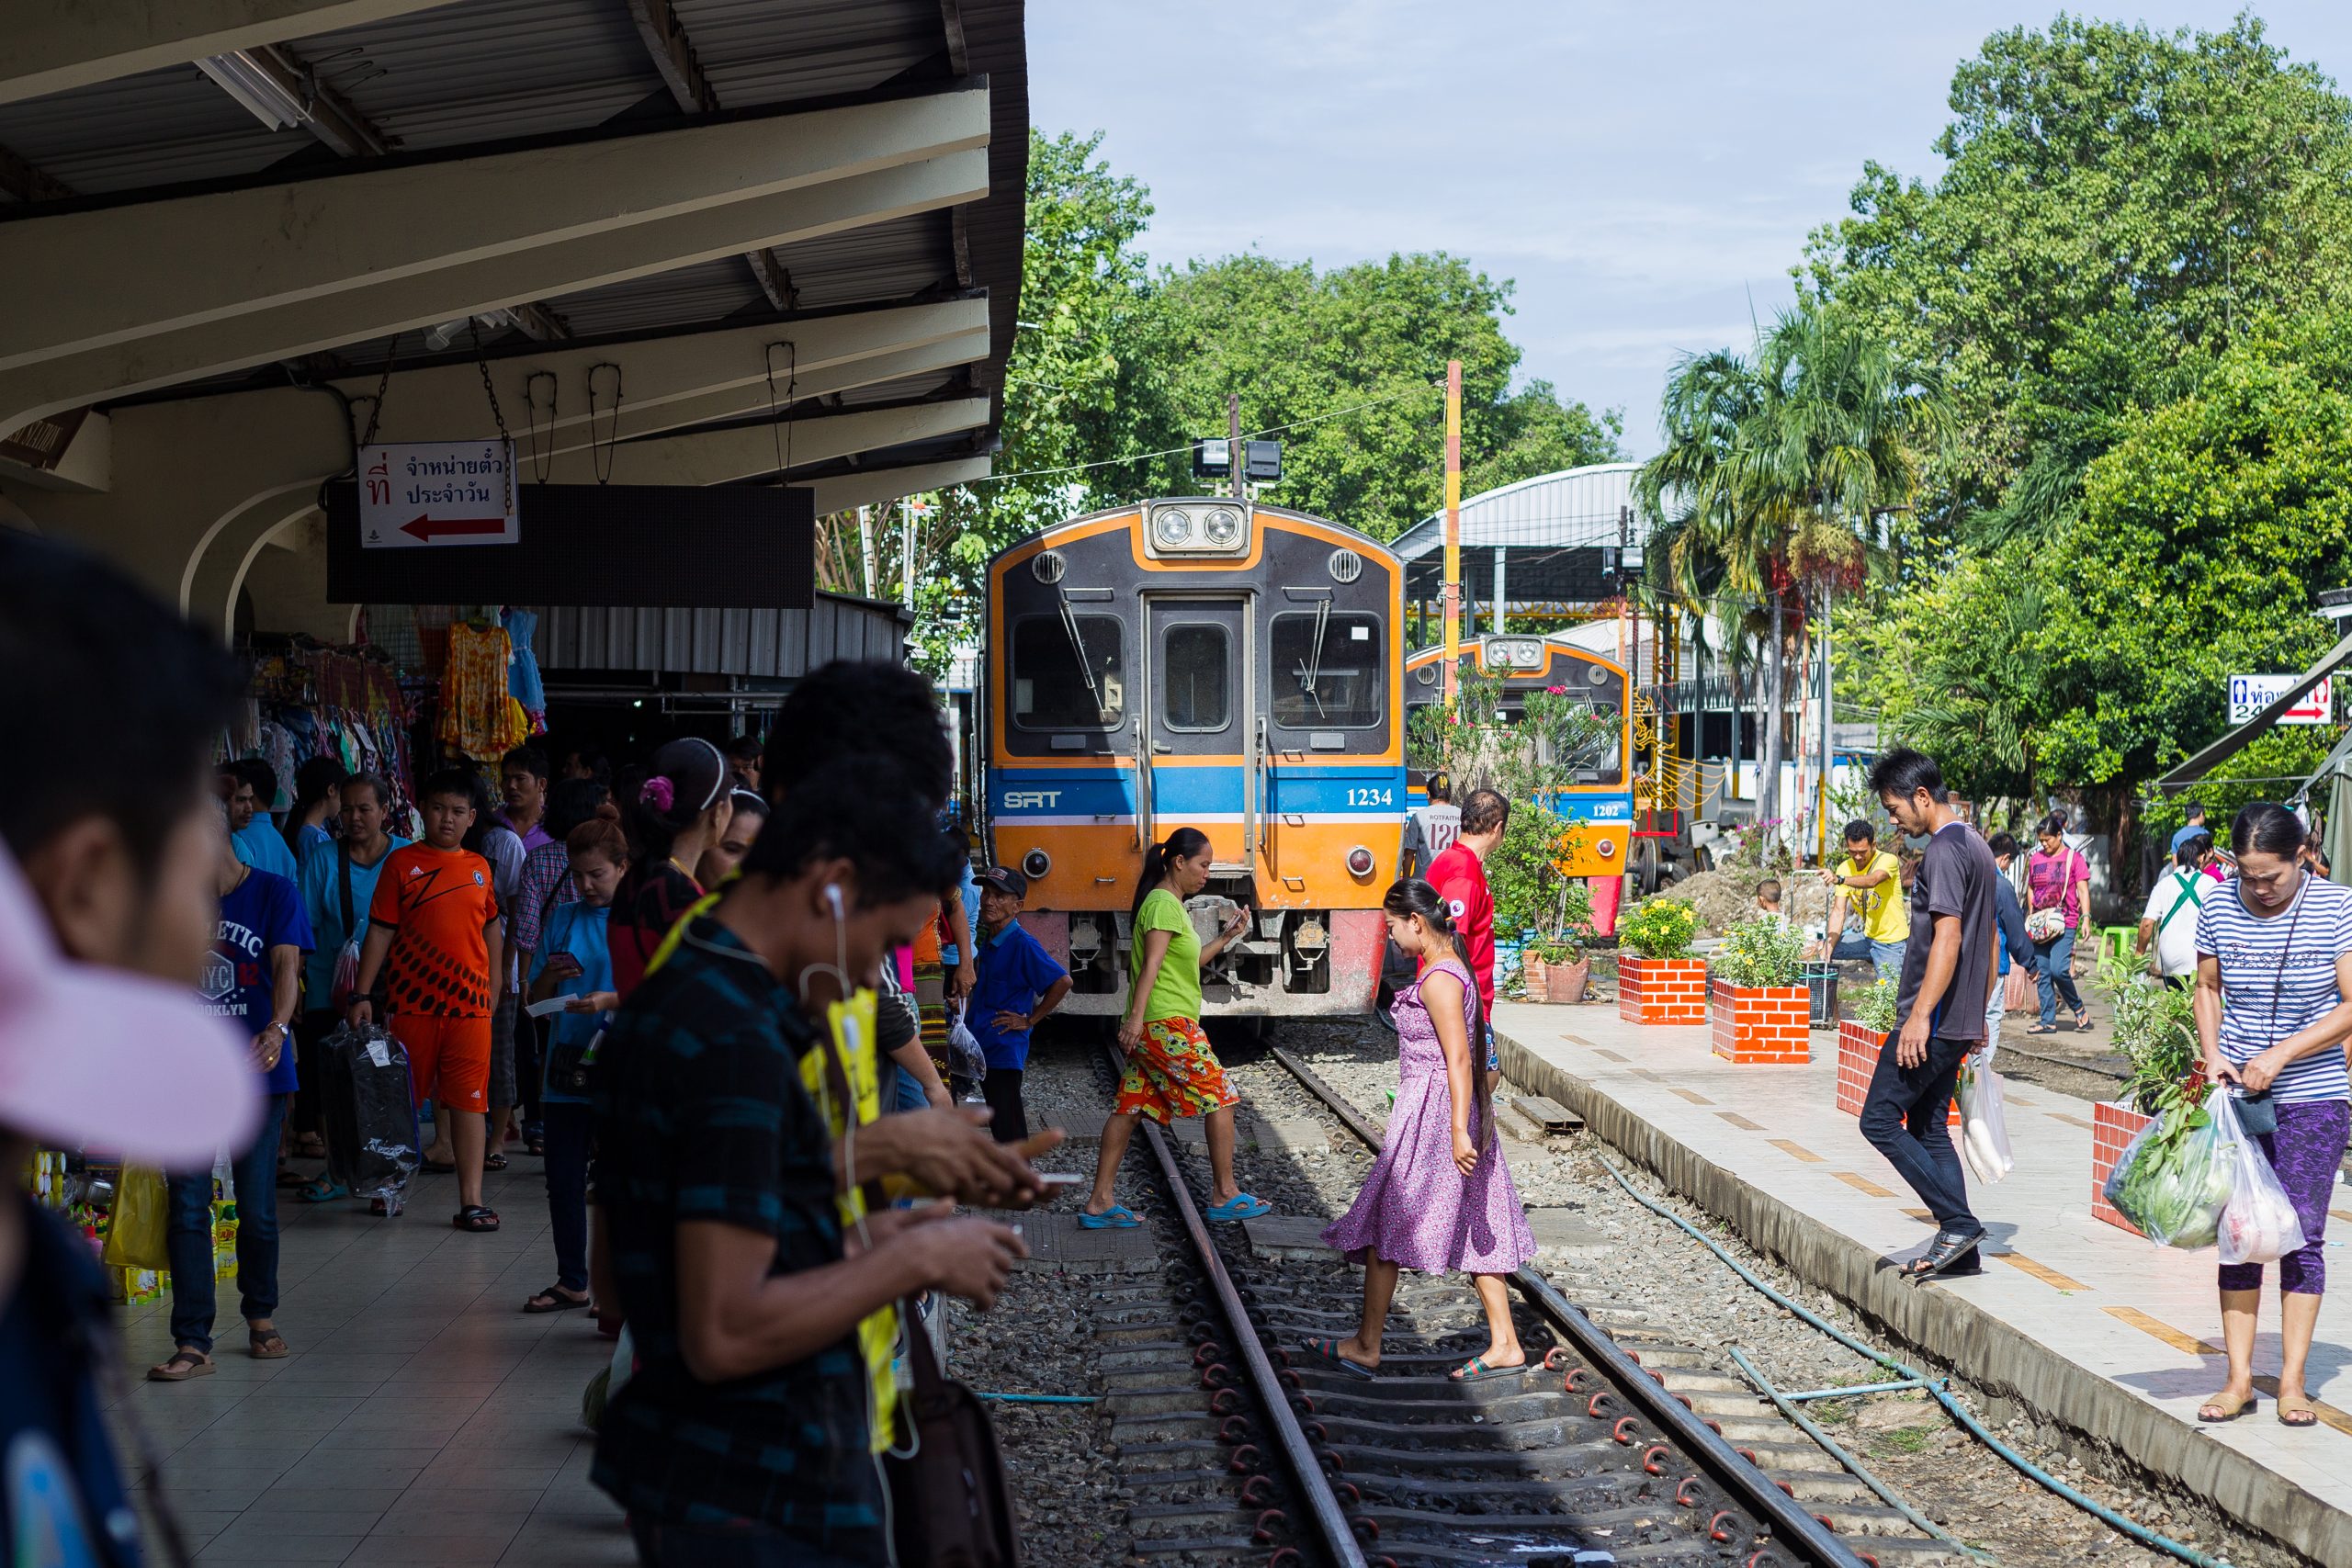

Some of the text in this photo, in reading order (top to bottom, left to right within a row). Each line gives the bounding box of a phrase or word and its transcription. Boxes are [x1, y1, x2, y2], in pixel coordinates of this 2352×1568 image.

[406, 447, 503, 476] จำหน่ายตั๋ว
[366, 452, 390, 505] ที่
[407, 481, 490, 504] ประจำวัน
[1004, 791, 1062, 808] SRT
[1347, 788, 1393, 807] 1234
[1593, 805, 1619, 817] 1202
[216, 920, 264, 958] ETIC
[197, 1003, 248, 1017] OOKLYN
